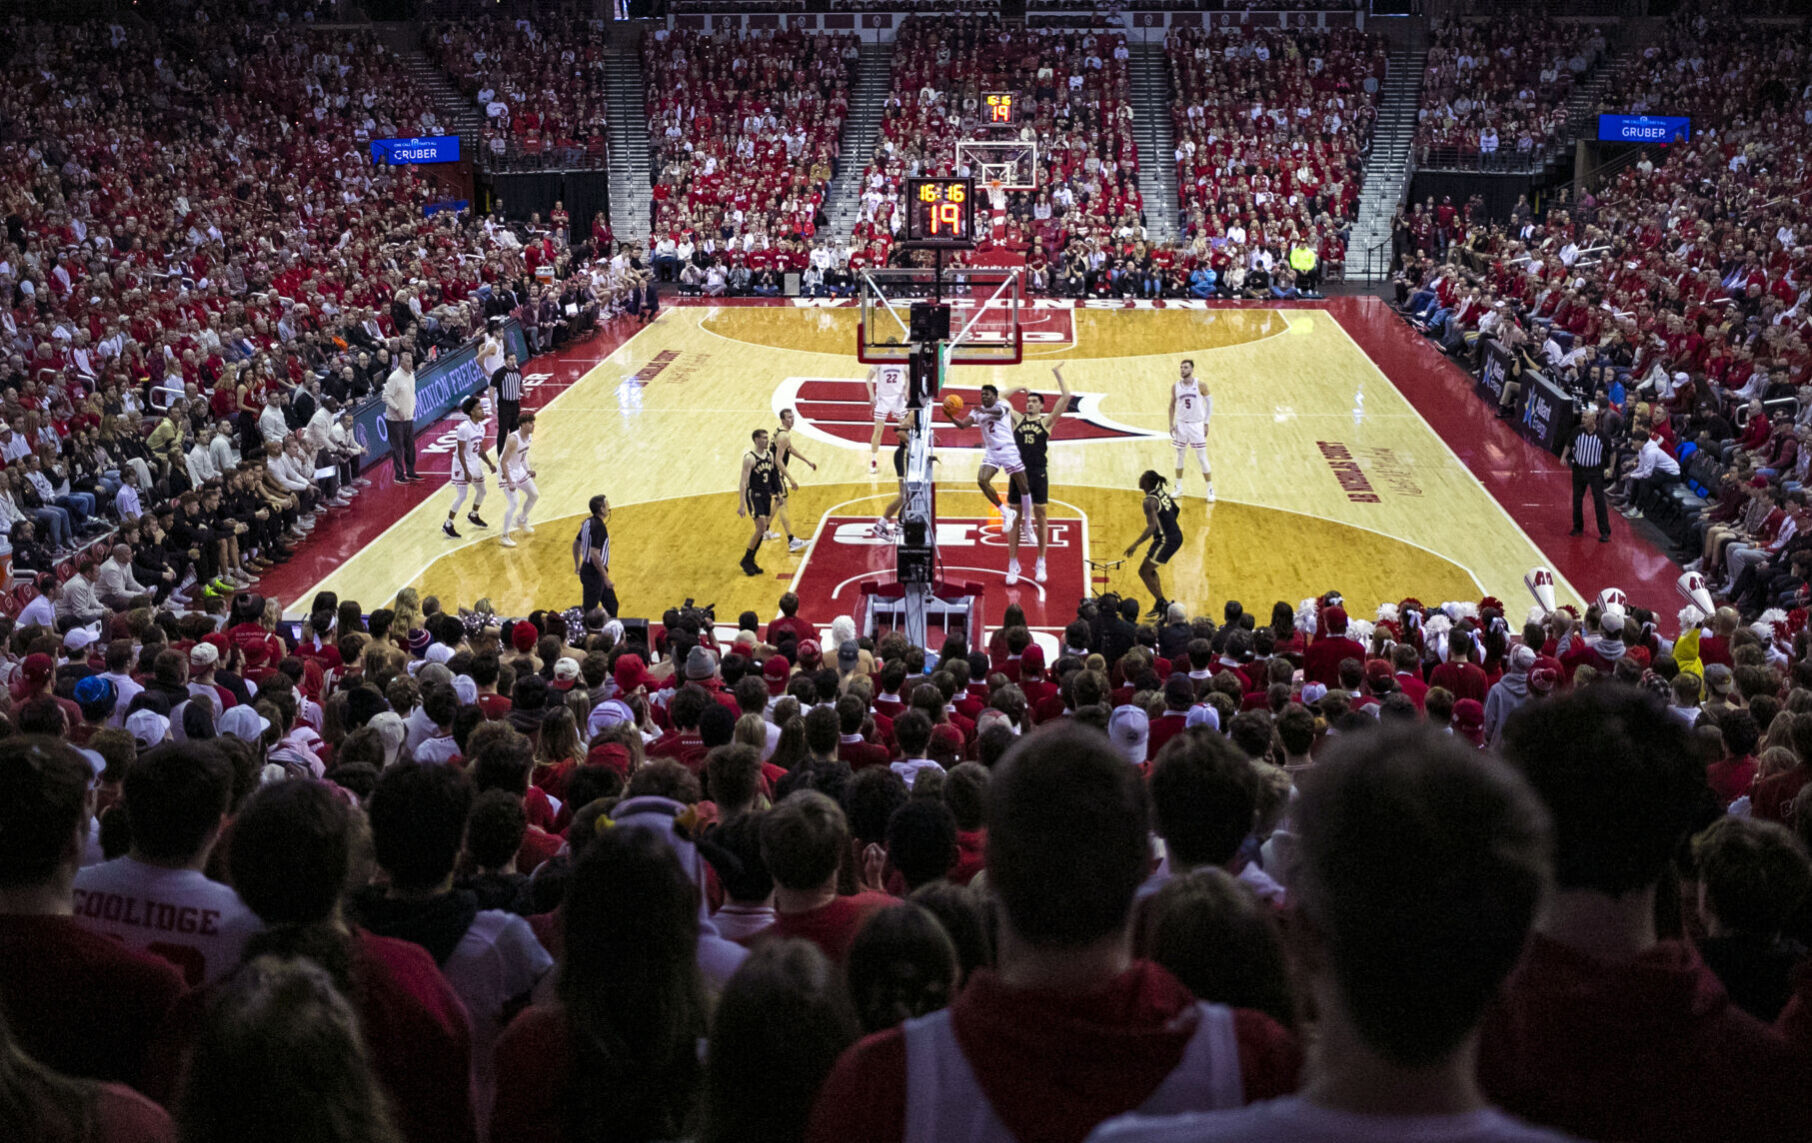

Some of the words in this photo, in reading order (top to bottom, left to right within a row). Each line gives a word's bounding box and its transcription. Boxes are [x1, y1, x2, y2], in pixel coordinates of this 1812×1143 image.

[993, 105, 1009, 122] 19
[1622, 126, 1666, 138] GRUBER
[394, 148, 437, 160] GRUBER
[931, 204, 959, 234] 19
[886, 373, 898, 384] 22
[1184, 398, 1192, 410] 5
[1535, 396, 1552, 422] Alliant
[987, 420, 995, 434] 2
[1024, 433, 1035, 445] 15
[762, 472, 769, 484] 3
[72, 888, 221, 936] COOLIDGE
